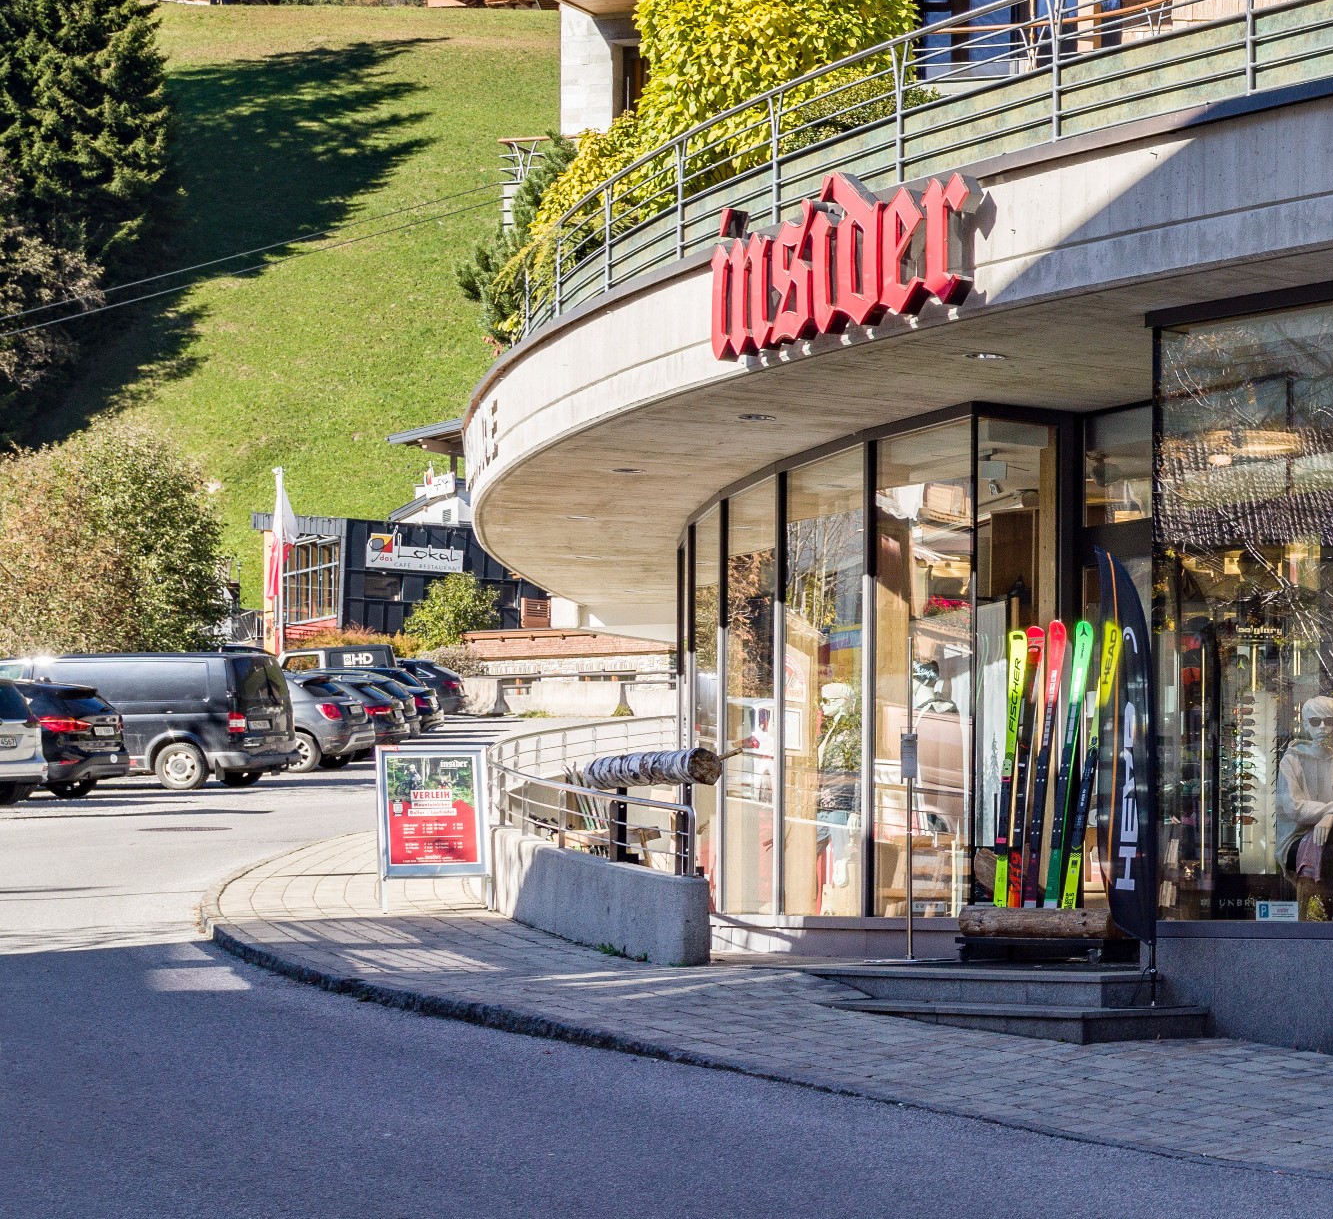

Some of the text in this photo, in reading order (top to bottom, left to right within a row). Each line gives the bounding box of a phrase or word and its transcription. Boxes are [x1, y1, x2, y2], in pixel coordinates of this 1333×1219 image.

[711, 170, 980, 362] insider
[419, 563, 461, 571] RESTAURANT
[1102, 629, 1117, 685] HEAD
[1009, 657, 1022, 734] FISCHER
[412, 791, 450, 800] VERLEIH
